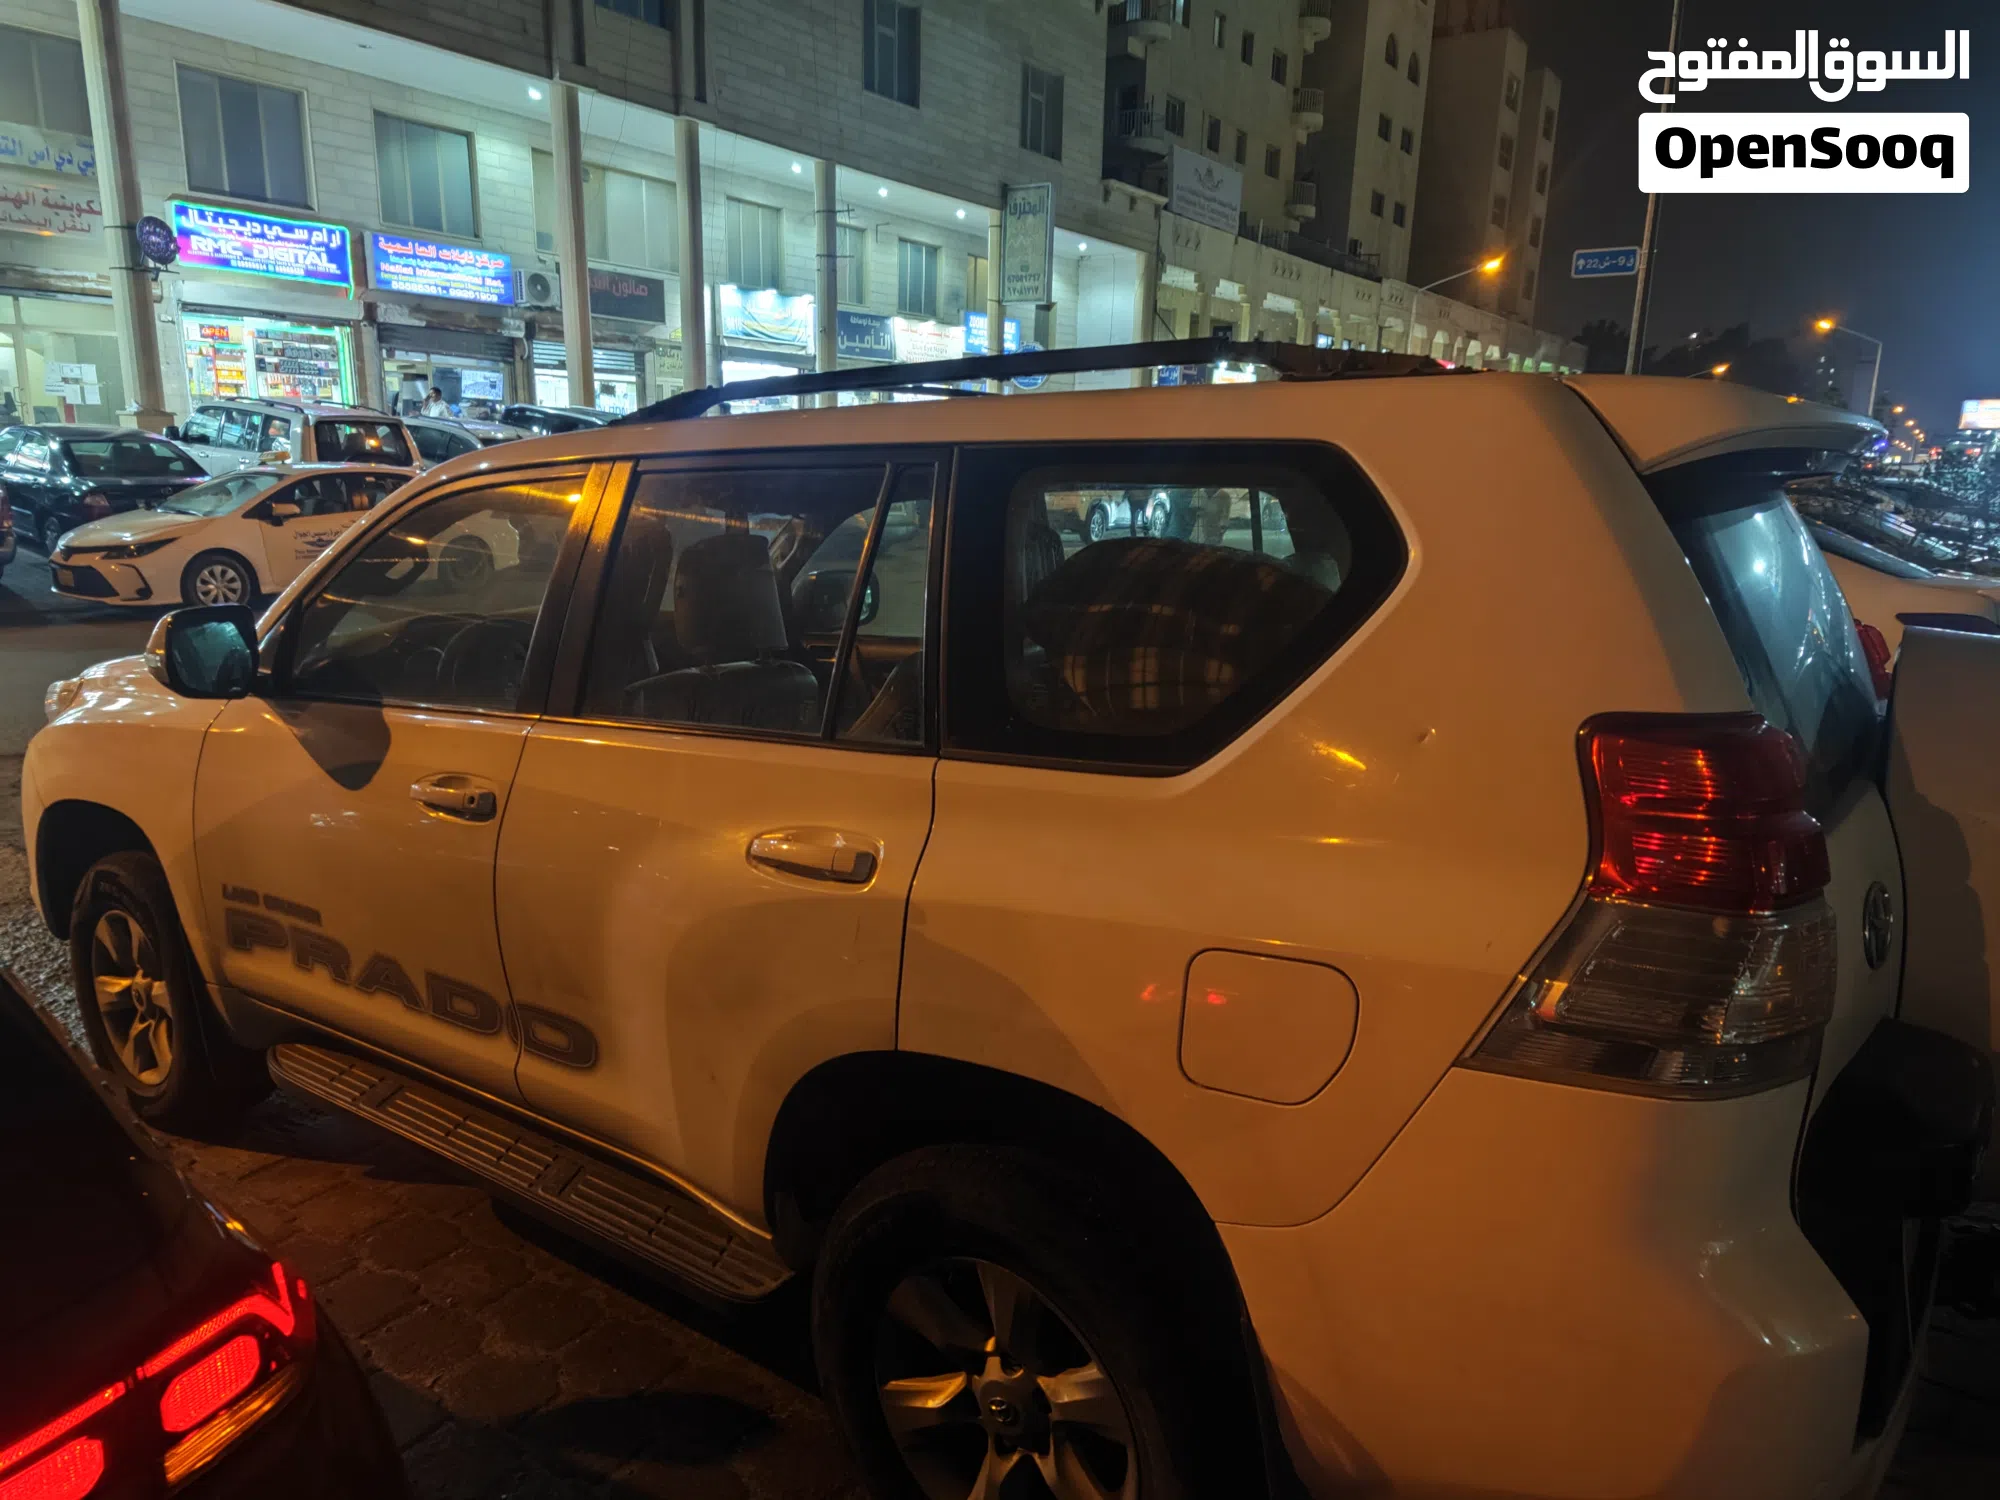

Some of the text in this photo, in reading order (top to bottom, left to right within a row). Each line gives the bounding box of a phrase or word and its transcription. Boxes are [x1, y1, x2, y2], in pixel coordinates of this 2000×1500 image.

[181, 208, 262, 237] ديجيتال
[190, 235, 243, 256] RMC
[253, 244, 337, 270] DIGITAL
[612, 277, 649, 298] صالون
[201, 326, 229, 337] OPEN
[838, 329, 891, 352] التأمين
[224, 907, 598, 1068] PRADO
